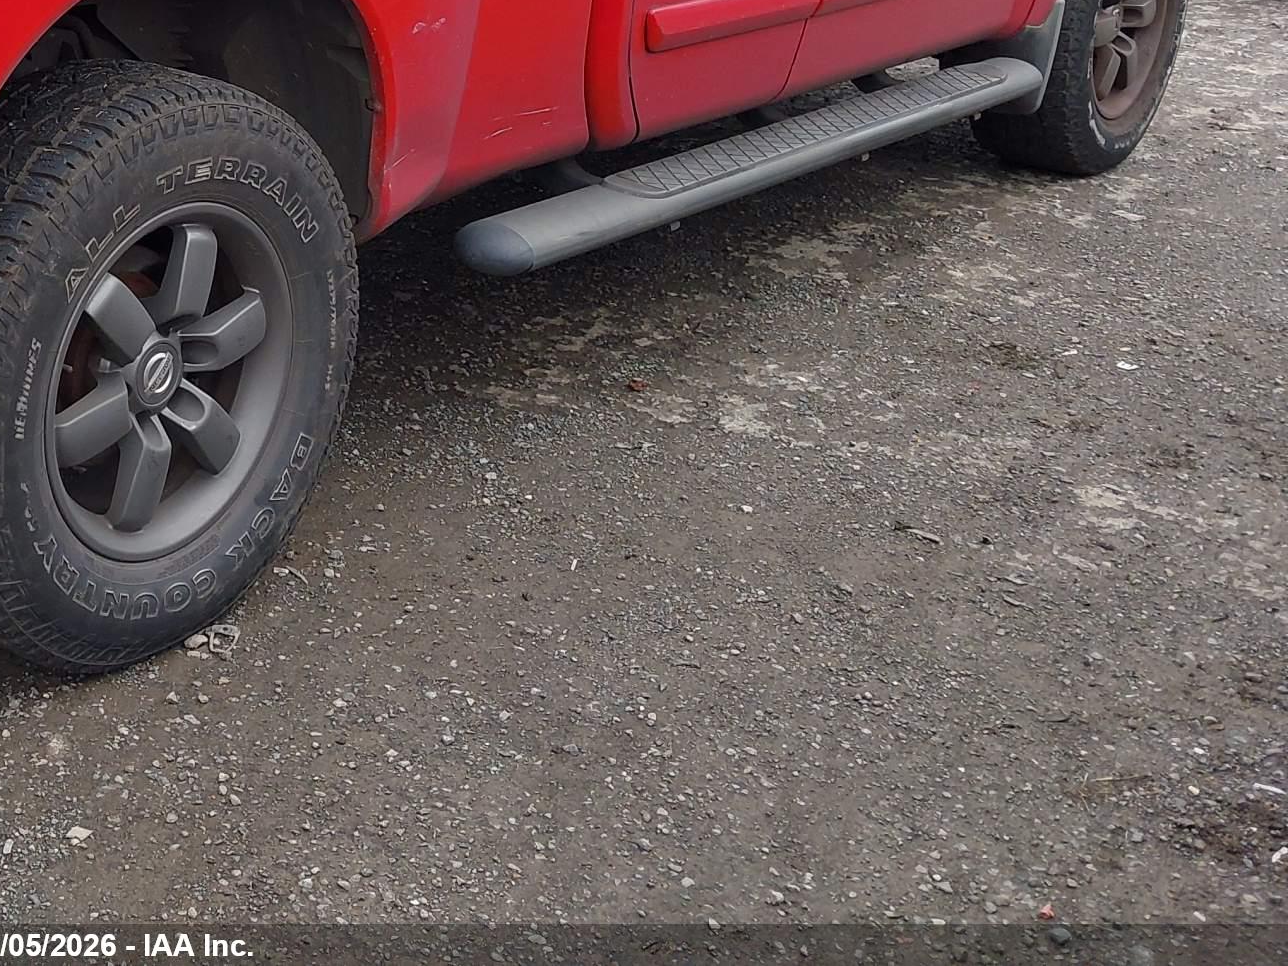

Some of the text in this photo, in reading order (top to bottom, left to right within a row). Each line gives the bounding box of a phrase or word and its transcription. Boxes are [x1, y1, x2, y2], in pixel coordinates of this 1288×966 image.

[64, 155, 320, 305] ALL TERRAIN
[32, 431, 314, 621] BACK COUNTRY
